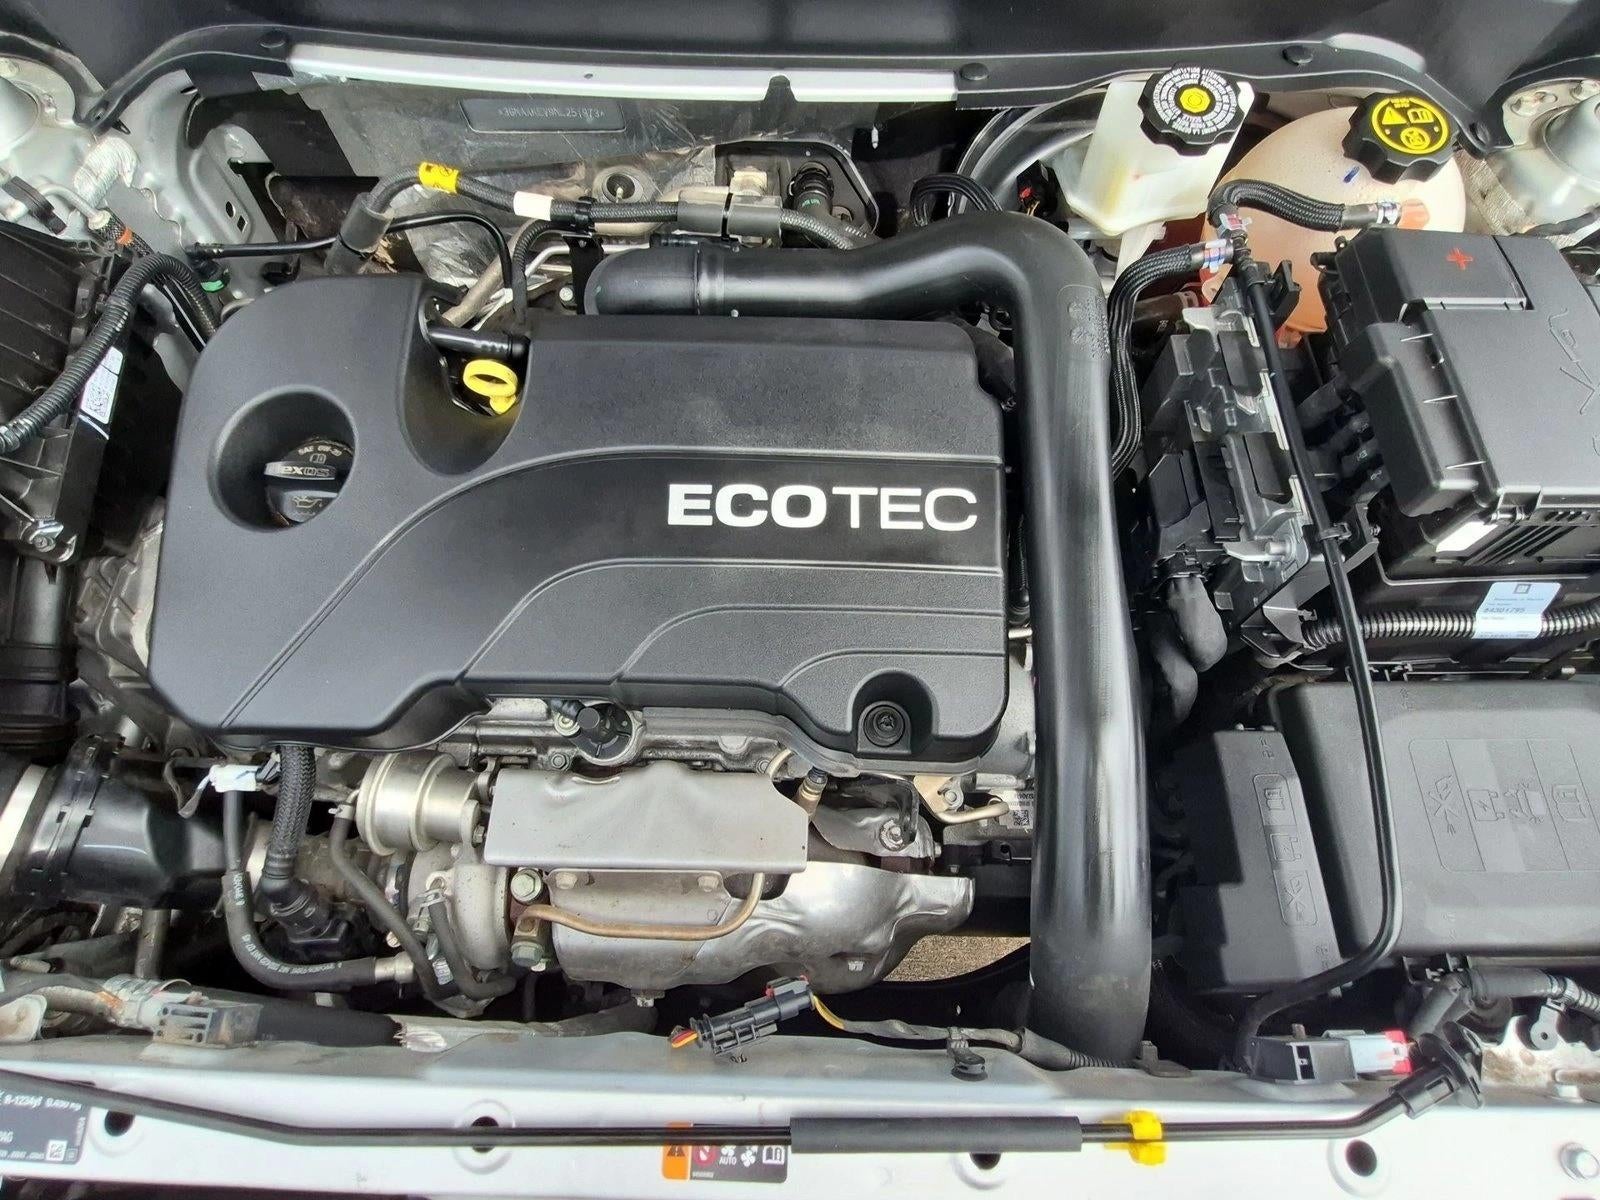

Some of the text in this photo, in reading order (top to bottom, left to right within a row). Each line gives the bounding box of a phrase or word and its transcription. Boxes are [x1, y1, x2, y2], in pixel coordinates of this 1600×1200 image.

[298, 445, 314, 455] SAE
[667, 483, 978, 532] ECOTEC
[719, 1156, 738, 1166] AUTO
